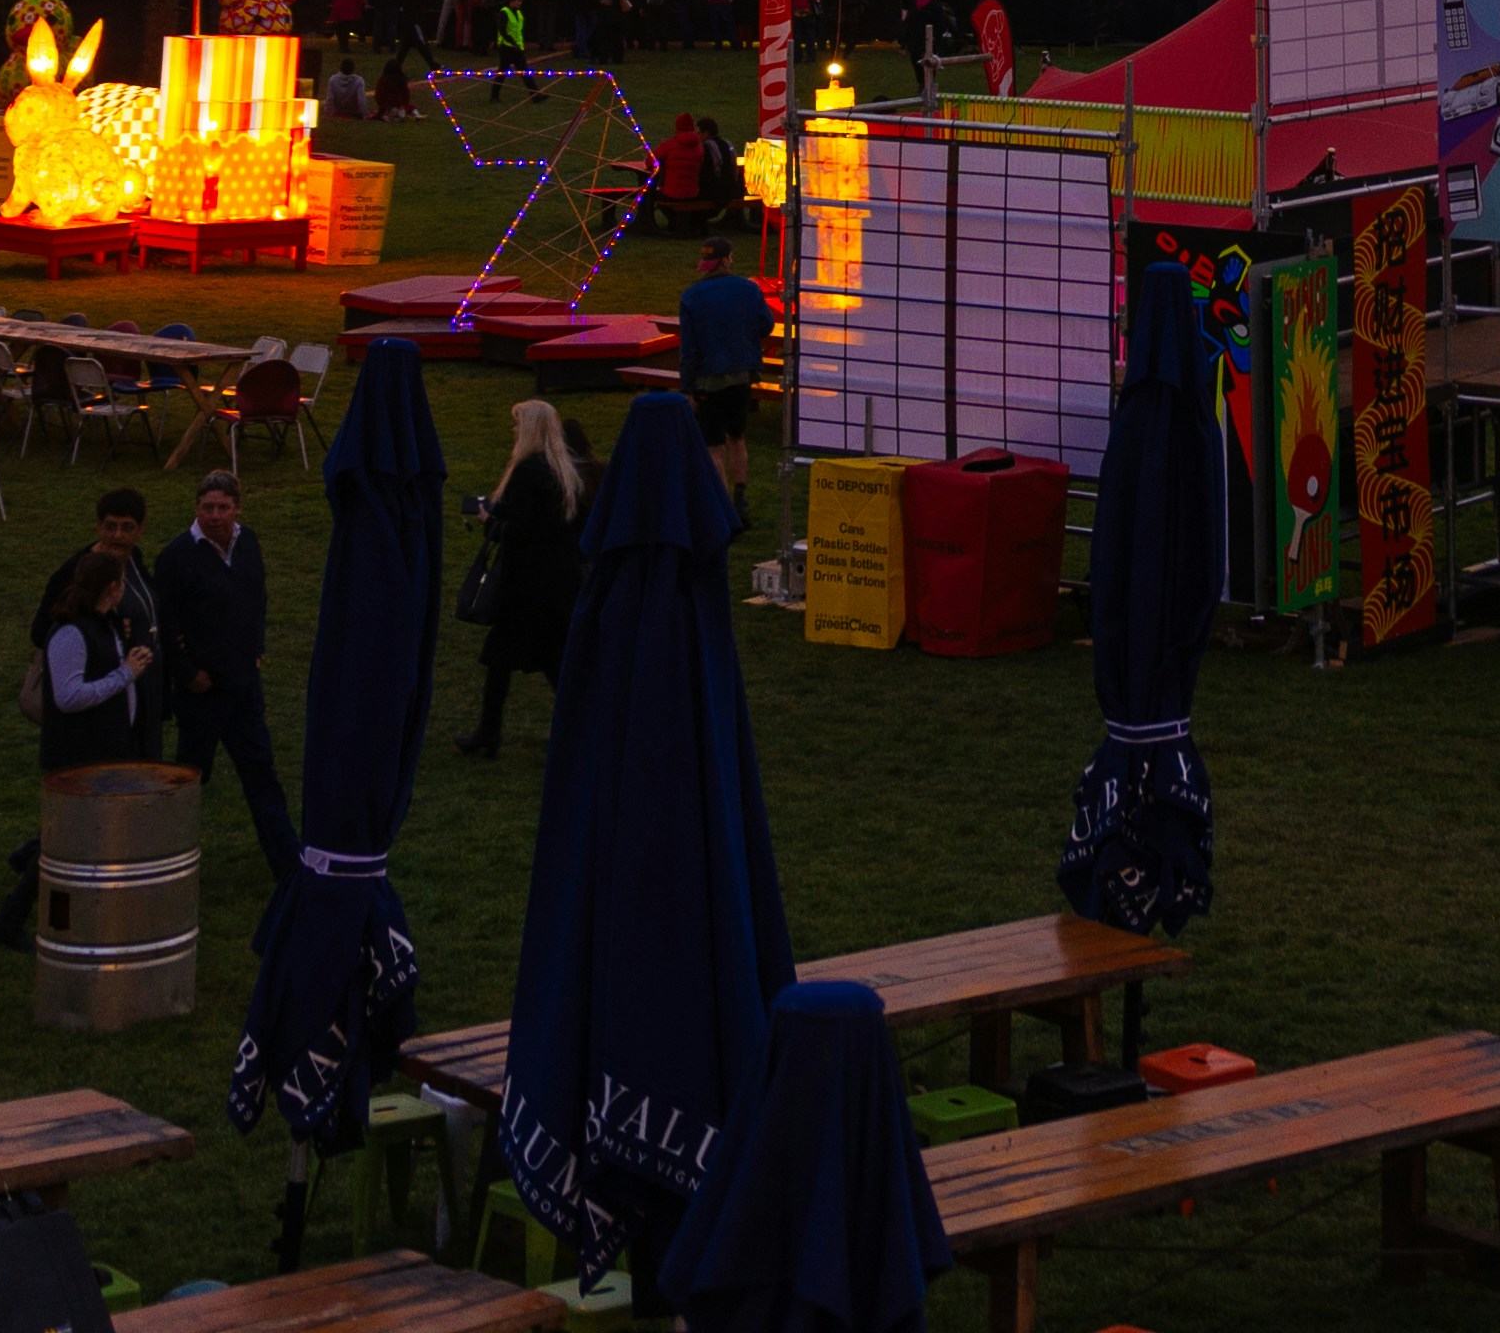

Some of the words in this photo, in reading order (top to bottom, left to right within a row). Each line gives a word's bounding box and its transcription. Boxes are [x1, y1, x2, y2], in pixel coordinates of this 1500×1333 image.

[1283, 265, 1328, 349] PING
[816, 478, 835, 491] 10c
[836, 478, 891, 495] DEPOSITS
[838, 521, 865, 536] Cans
[813, 536, 850, 551] Plastic
[852, 540, 889, 555] Bottles
[815, 553, 847, 567] Glass
[850, 556, 885, 572] Bottles
[1283, 511, 1333, 606] PONG
[813, 569, 844, 583] Drink
[846, 571, 886, 589] Cartons
[814, 617, 882, 635] greenClean
